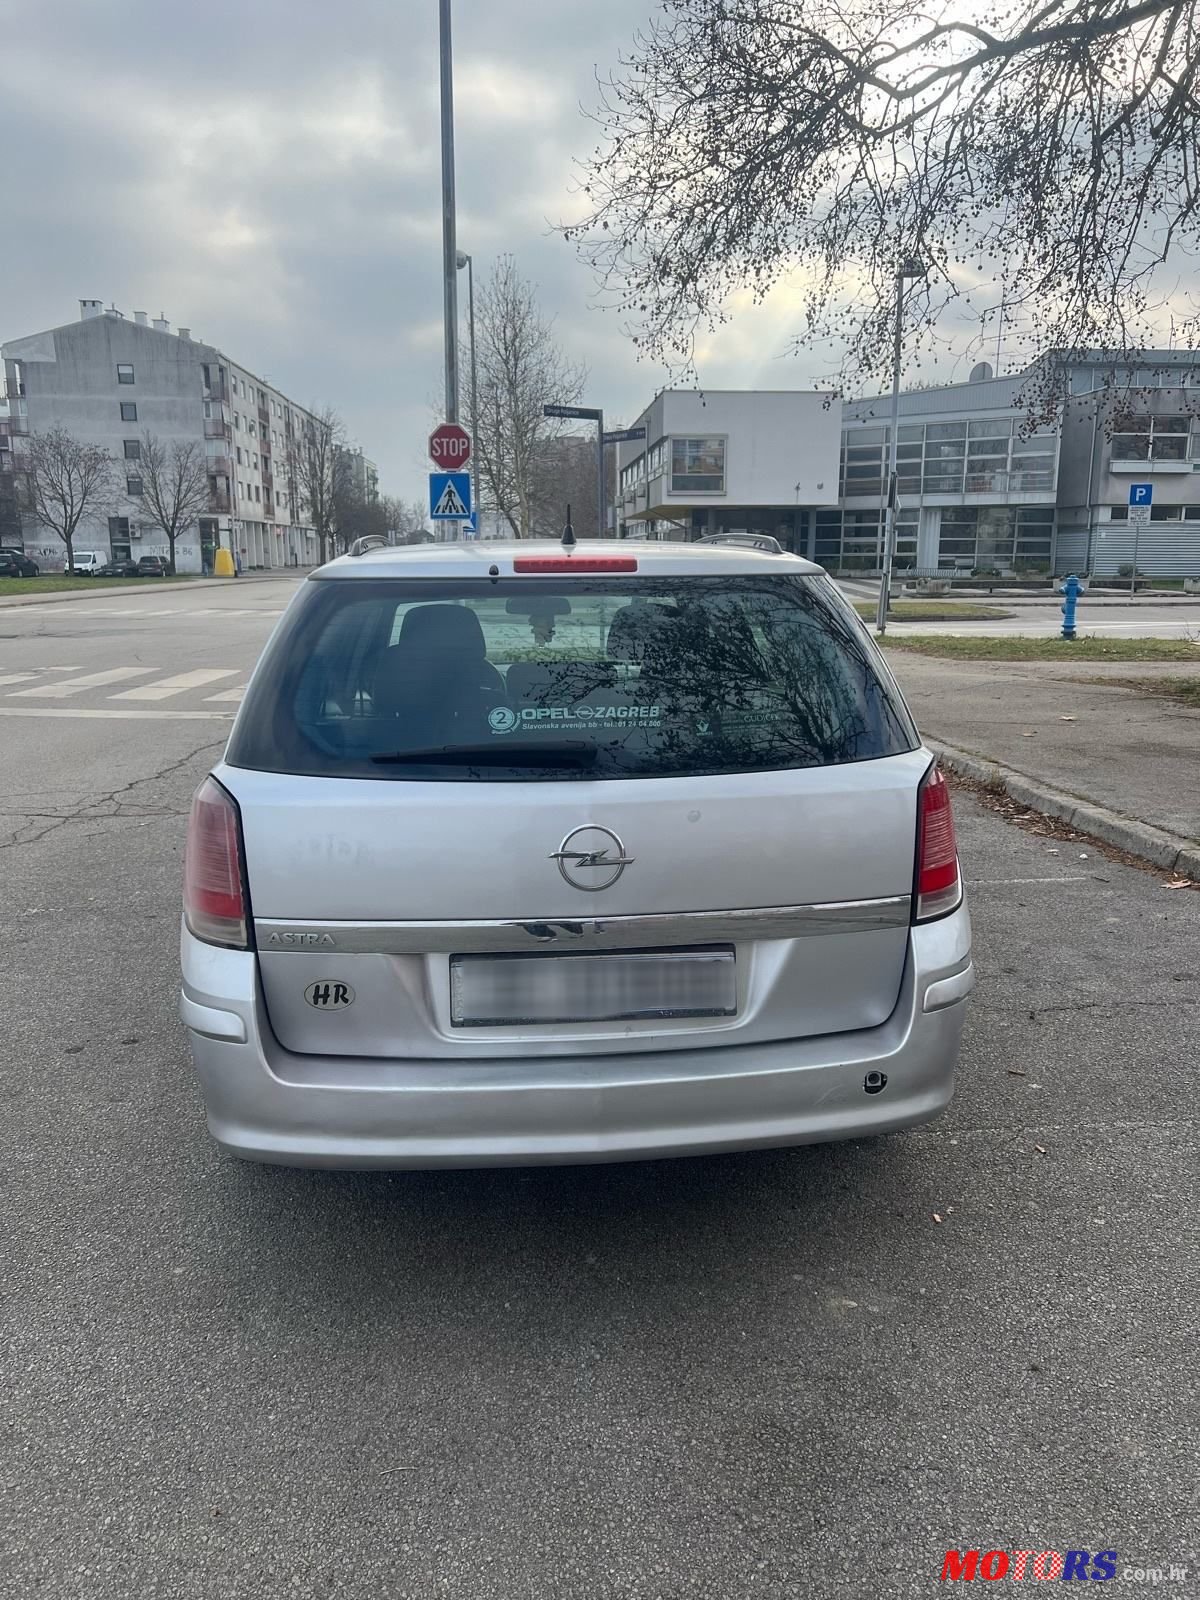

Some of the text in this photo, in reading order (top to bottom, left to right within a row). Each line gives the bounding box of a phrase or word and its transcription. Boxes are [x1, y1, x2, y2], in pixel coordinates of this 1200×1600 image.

[432, 438, 468, 457] STOP
[1135, 487, 1146, 501] P
[495, 711, 507, 724] 2
[521, 706, 660, 719] OPEL ZAGREB
[561, 722, 587, 730] avenija
[268, 932, 335, 945] ASTRA
[312, 984, 349, 1005] HR
